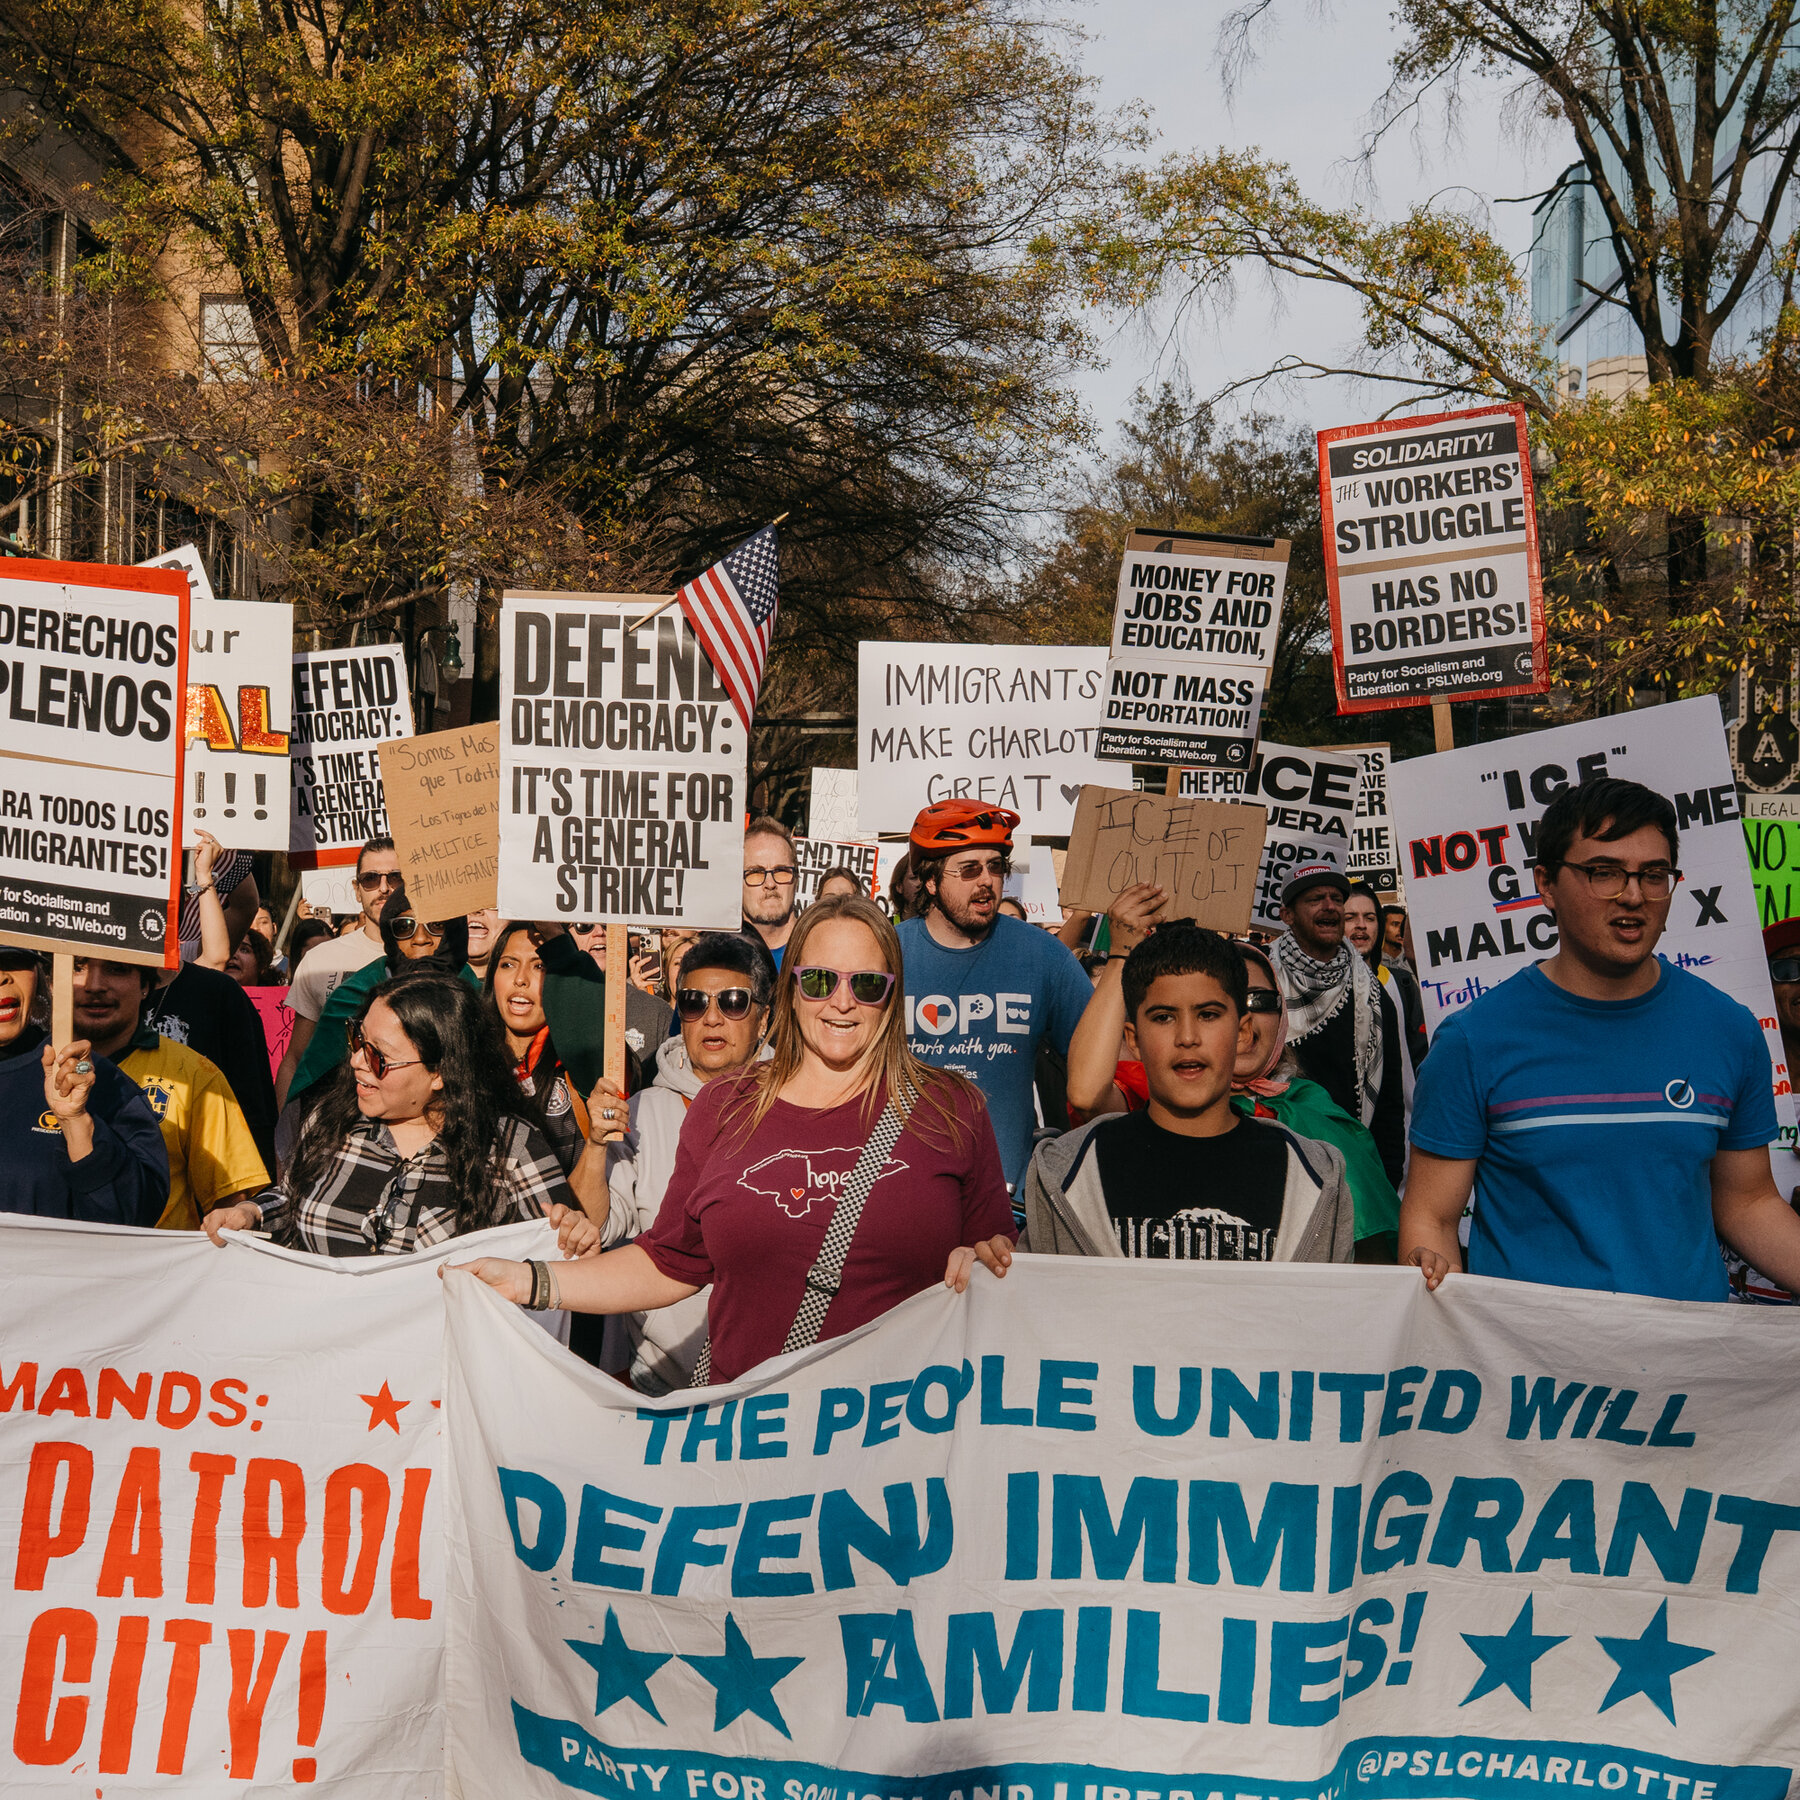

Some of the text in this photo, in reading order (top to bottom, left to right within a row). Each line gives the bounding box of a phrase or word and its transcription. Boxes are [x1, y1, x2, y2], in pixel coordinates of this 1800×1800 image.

[1352, 432, 1494, 470] SOLIDARITY!
[1335, 462, 1519, 508] THE WORKERS'
[1336, 497, 1526, 554] STRUGGLE
[1130, 563, 1275, 598] MONEY FOR
[1371, 567, 1498, 613] HAS NO
[1124, 592, 1272, 628] JOBS AND
[1350, 601, 1528, 655] BORDERS!
[1121, 622, 1266, 660] EDUCATION,
[292, 656, 398, 713] EFEND
[886, 663, 1102, 706] IMMIGRANTS
[1111, 669, 1254, 706] NOT MASS
[1348, 656, 1485, 686] Party for Socialism and
[1350, 670, 1503, 698] Liberation PSLWeb.org
[511, 698, 733, 754] DEMOCRACY:
[1106, 700, 1251, 729] DEPORTATION!
[461, 735, 495, 758] Mas
[870, 725, 953, 762] MAKE
[1100, 744, 1147, 757] Liberation
[1159, 748, 1217, 762] PSLWeb.org
[1102, 733, 1207, 749] Party for Socialism and
[318, 751, 367, 783] TIME
[420, 774, 447, 797] que
[1244, 752, 1358, 812] ICE
[298, 786, 311, 816] A
[512, 766, 733, 823] IT'S TIME FOR
[927, 773, 1052, 812] GREAT
[1750, 802, 1799, 817] LEGAL
[40, 794, 116, 831] TODOS
[124, 805, 169, 838] LOS
[313, 808, 391, 843] STRIKE!
[1095, 795, 1244, 861] ICE OF
[409, 832, 488, 866] #MELTICE
[532, 816, 709, 869] A GENERAL
[836, 844, 876, 875] THE
[1409, 824, 1511, 880] NOT
[556, 863, 685, 916] STRIKE!
[1108, 850, 1194, 894] OUT
[1192, 864, 1245, 900] CLT
[3, 887, 110, 916] for Socialism and
[47, 912, 127, 941] PSLWeb.org
[1426, 914, 1559, 968] MALC
[1690, 885, 1729, 928] X
[1674, 952, 1715, 969] the
[948, 1036, 984, 1055] with
[986, 1043, 1017, 1060] you.
[806, 1159, 852, 1193] hope
[636, 1392, 790, 1465] THE
[1133, 1365, 1483, 1442] UNITED
[1506, 1374, 1697, 1448] WILL
[14, 1441, 433, 1620] PATROL
[1005, 1470, 1800, 1594] IMMIGRANT
[13, 1607, 327, 1783] CITY!
[561, 1736, 670, 1791] PARTY
[686, 1769, 767, 1800] FOR
[1357, 1750, 1718, 1800] @PSLCHARLOTTE
